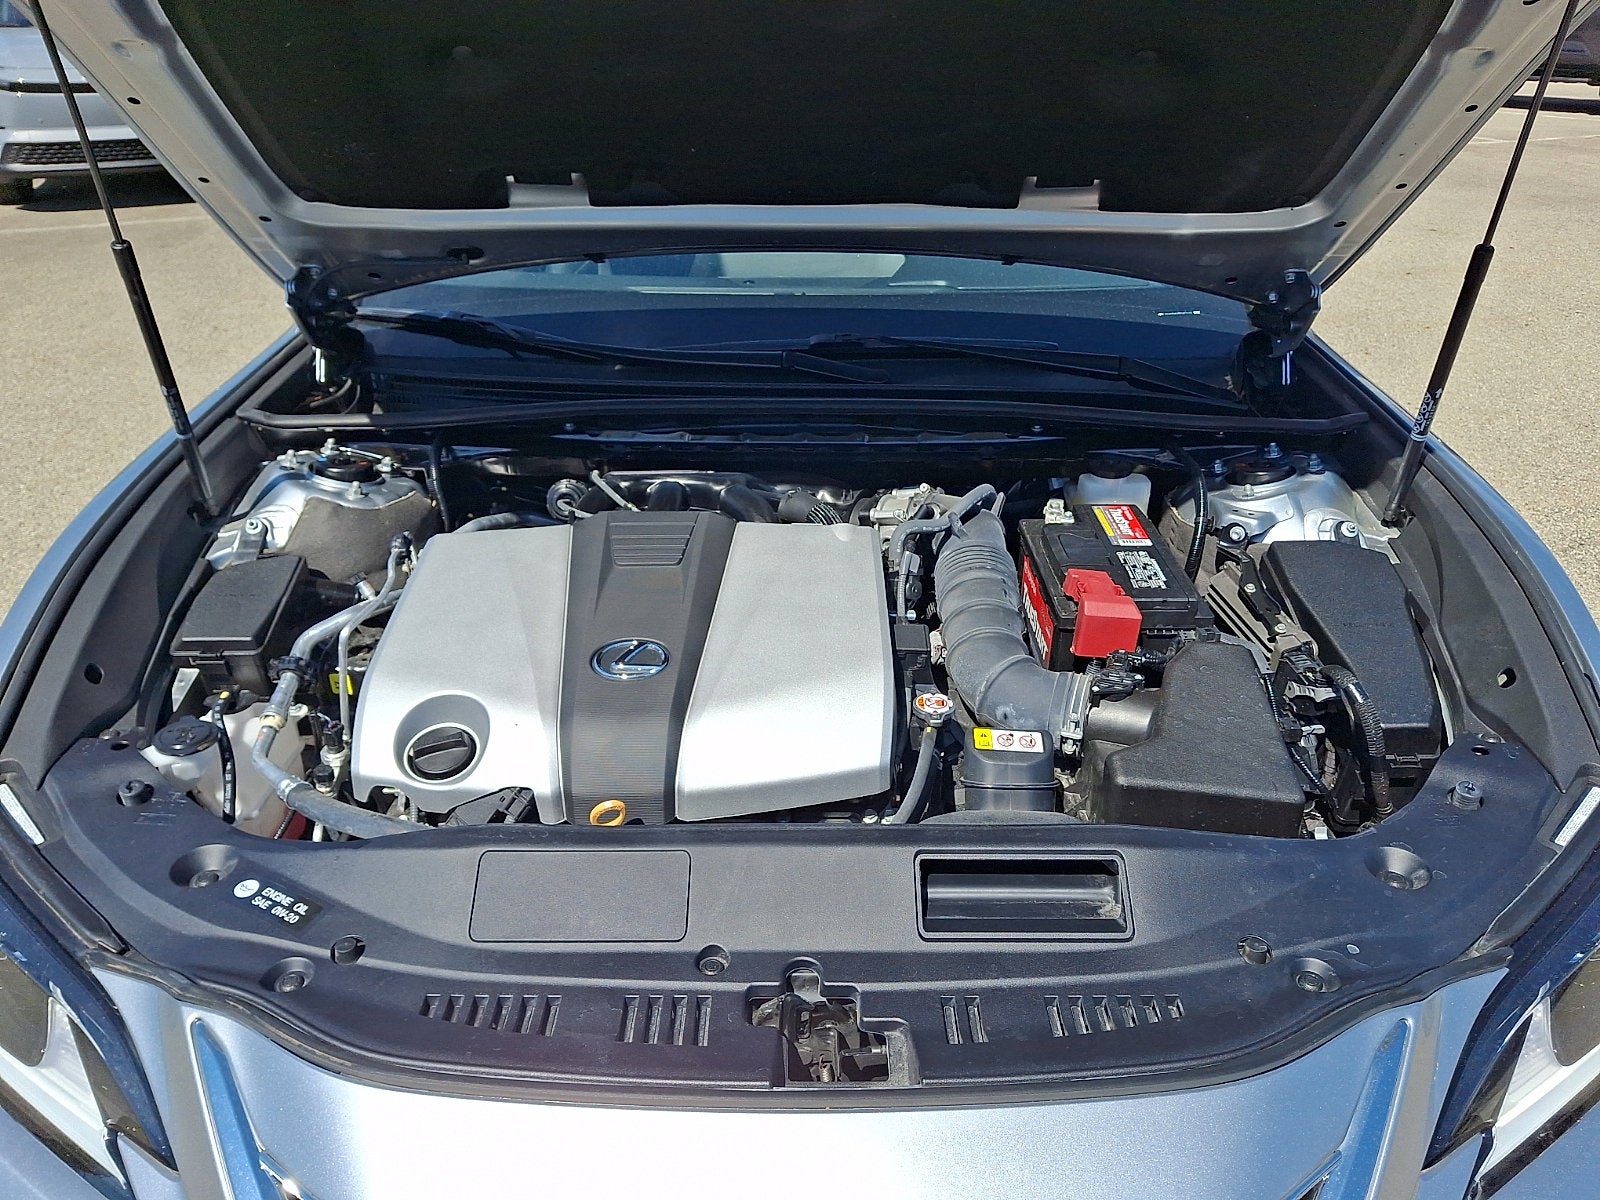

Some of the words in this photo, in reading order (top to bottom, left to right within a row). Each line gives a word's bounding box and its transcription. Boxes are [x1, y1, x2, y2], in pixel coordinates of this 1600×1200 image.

[251, 896, 273, 910] SAE
[271, 905, 300, 924] 0W-20
[261, 887, 295, 907] ENGINE
[293, 902, 309, 915] OIL
